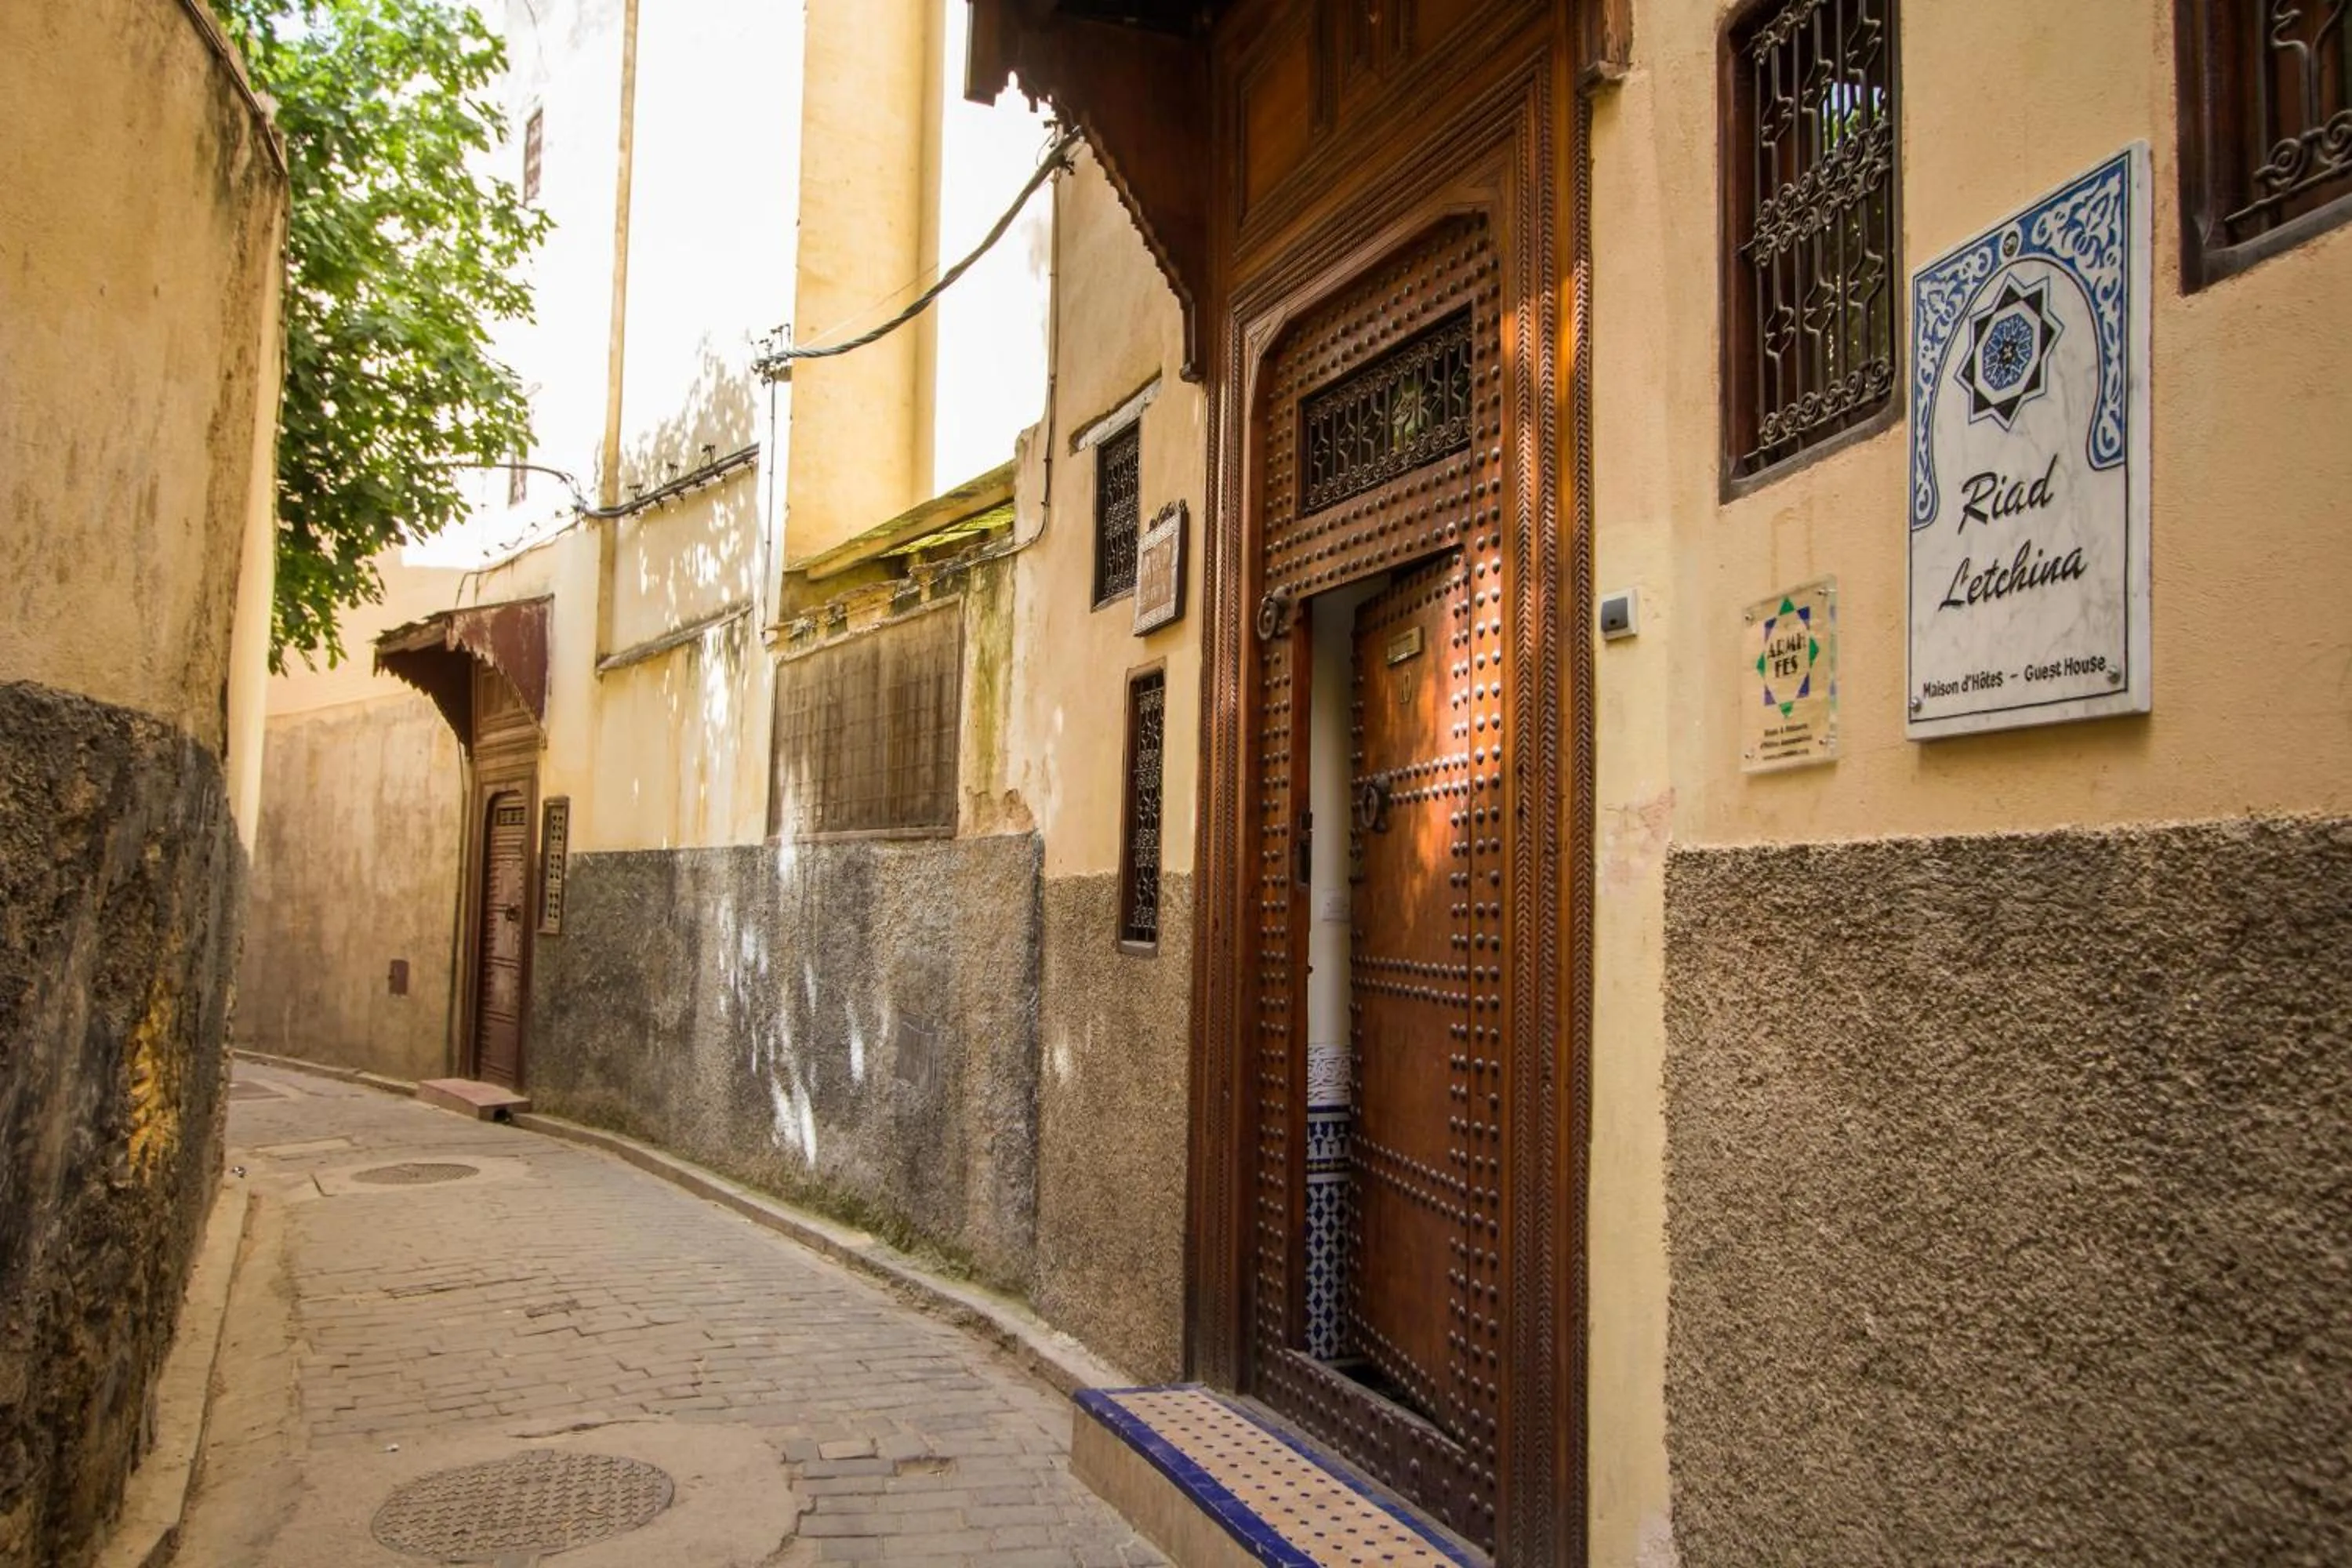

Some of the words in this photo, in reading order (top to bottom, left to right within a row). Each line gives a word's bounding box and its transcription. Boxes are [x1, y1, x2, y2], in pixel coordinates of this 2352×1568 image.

[1958, 453, 2057, 534] Riad
[1938, 539, 2087, 611] Letchina
[1923, 681, 1958, 698] Maison
[1962, 671, 2004, 691] d'Hôtes
[2024, 663, 2061, 682] Guest
[2064, 655, 2106, 676] House
